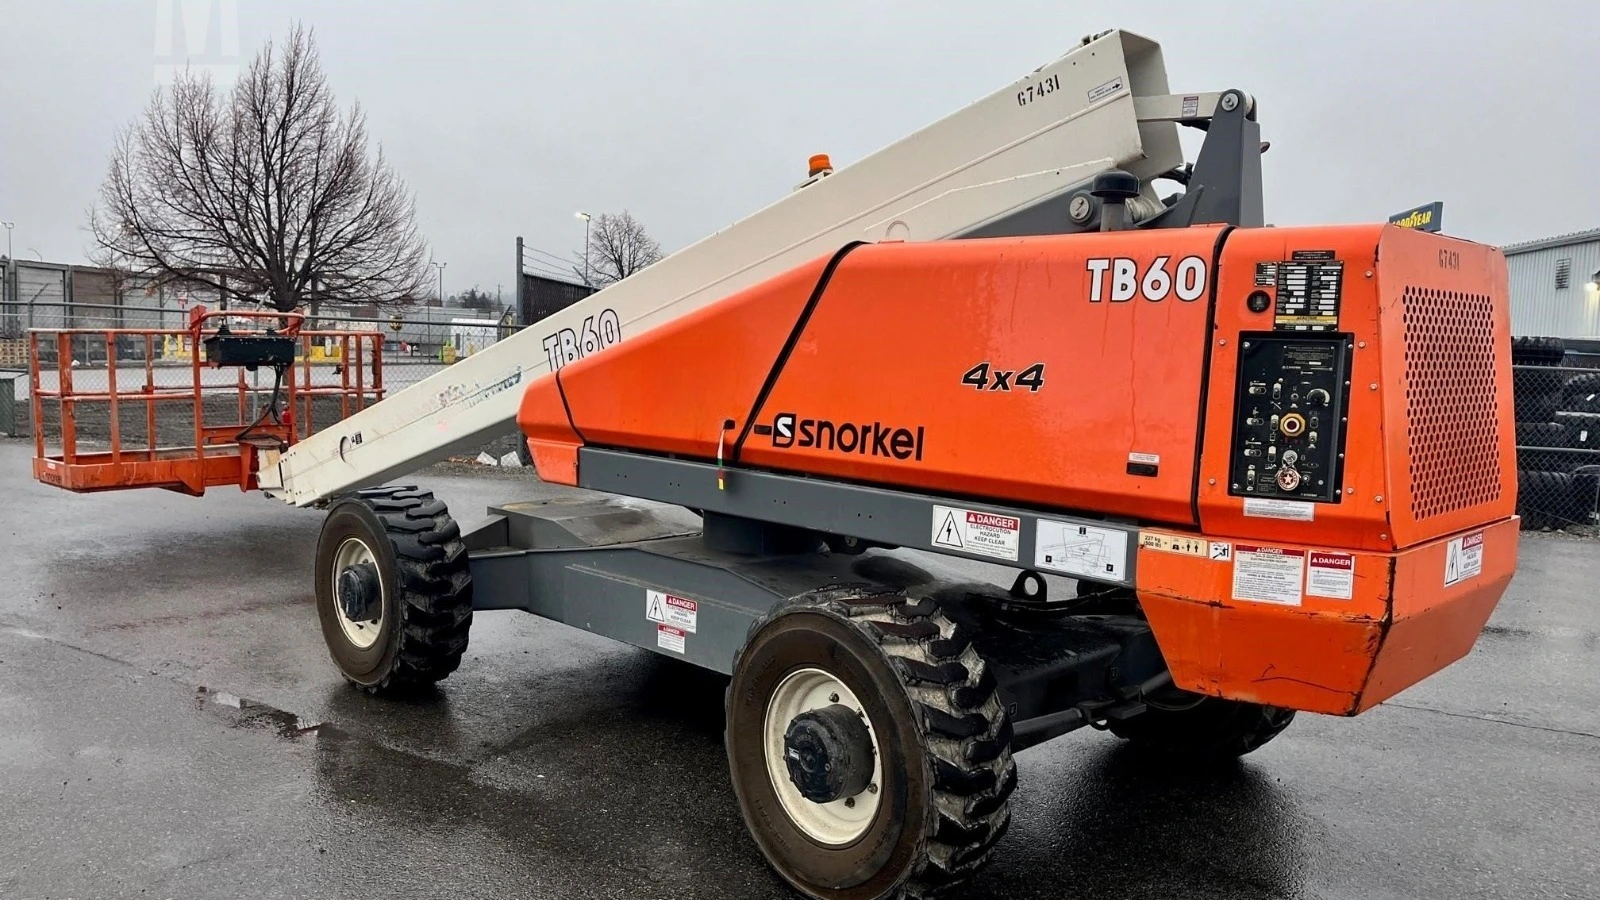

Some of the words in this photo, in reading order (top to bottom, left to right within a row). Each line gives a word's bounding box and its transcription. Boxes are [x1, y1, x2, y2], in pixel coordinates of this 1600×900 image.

[1017, 74, 1060, 107] G7431
[1438, 249, 1460, 271] G7431
[1086, 255, 1207, 302] TB60
[542, 308, 621, 372] TB60
[961, 361, 1046, 392] 4x4
[798, 417, 925, 461] snorkel
[970, 524, 1011, 534] ELECTROCUTION
[977, 515, 1014, 528] DANGER
[1318, 557, 1351, 566] DANGER
[672, 599, 695, 610] DANGER
